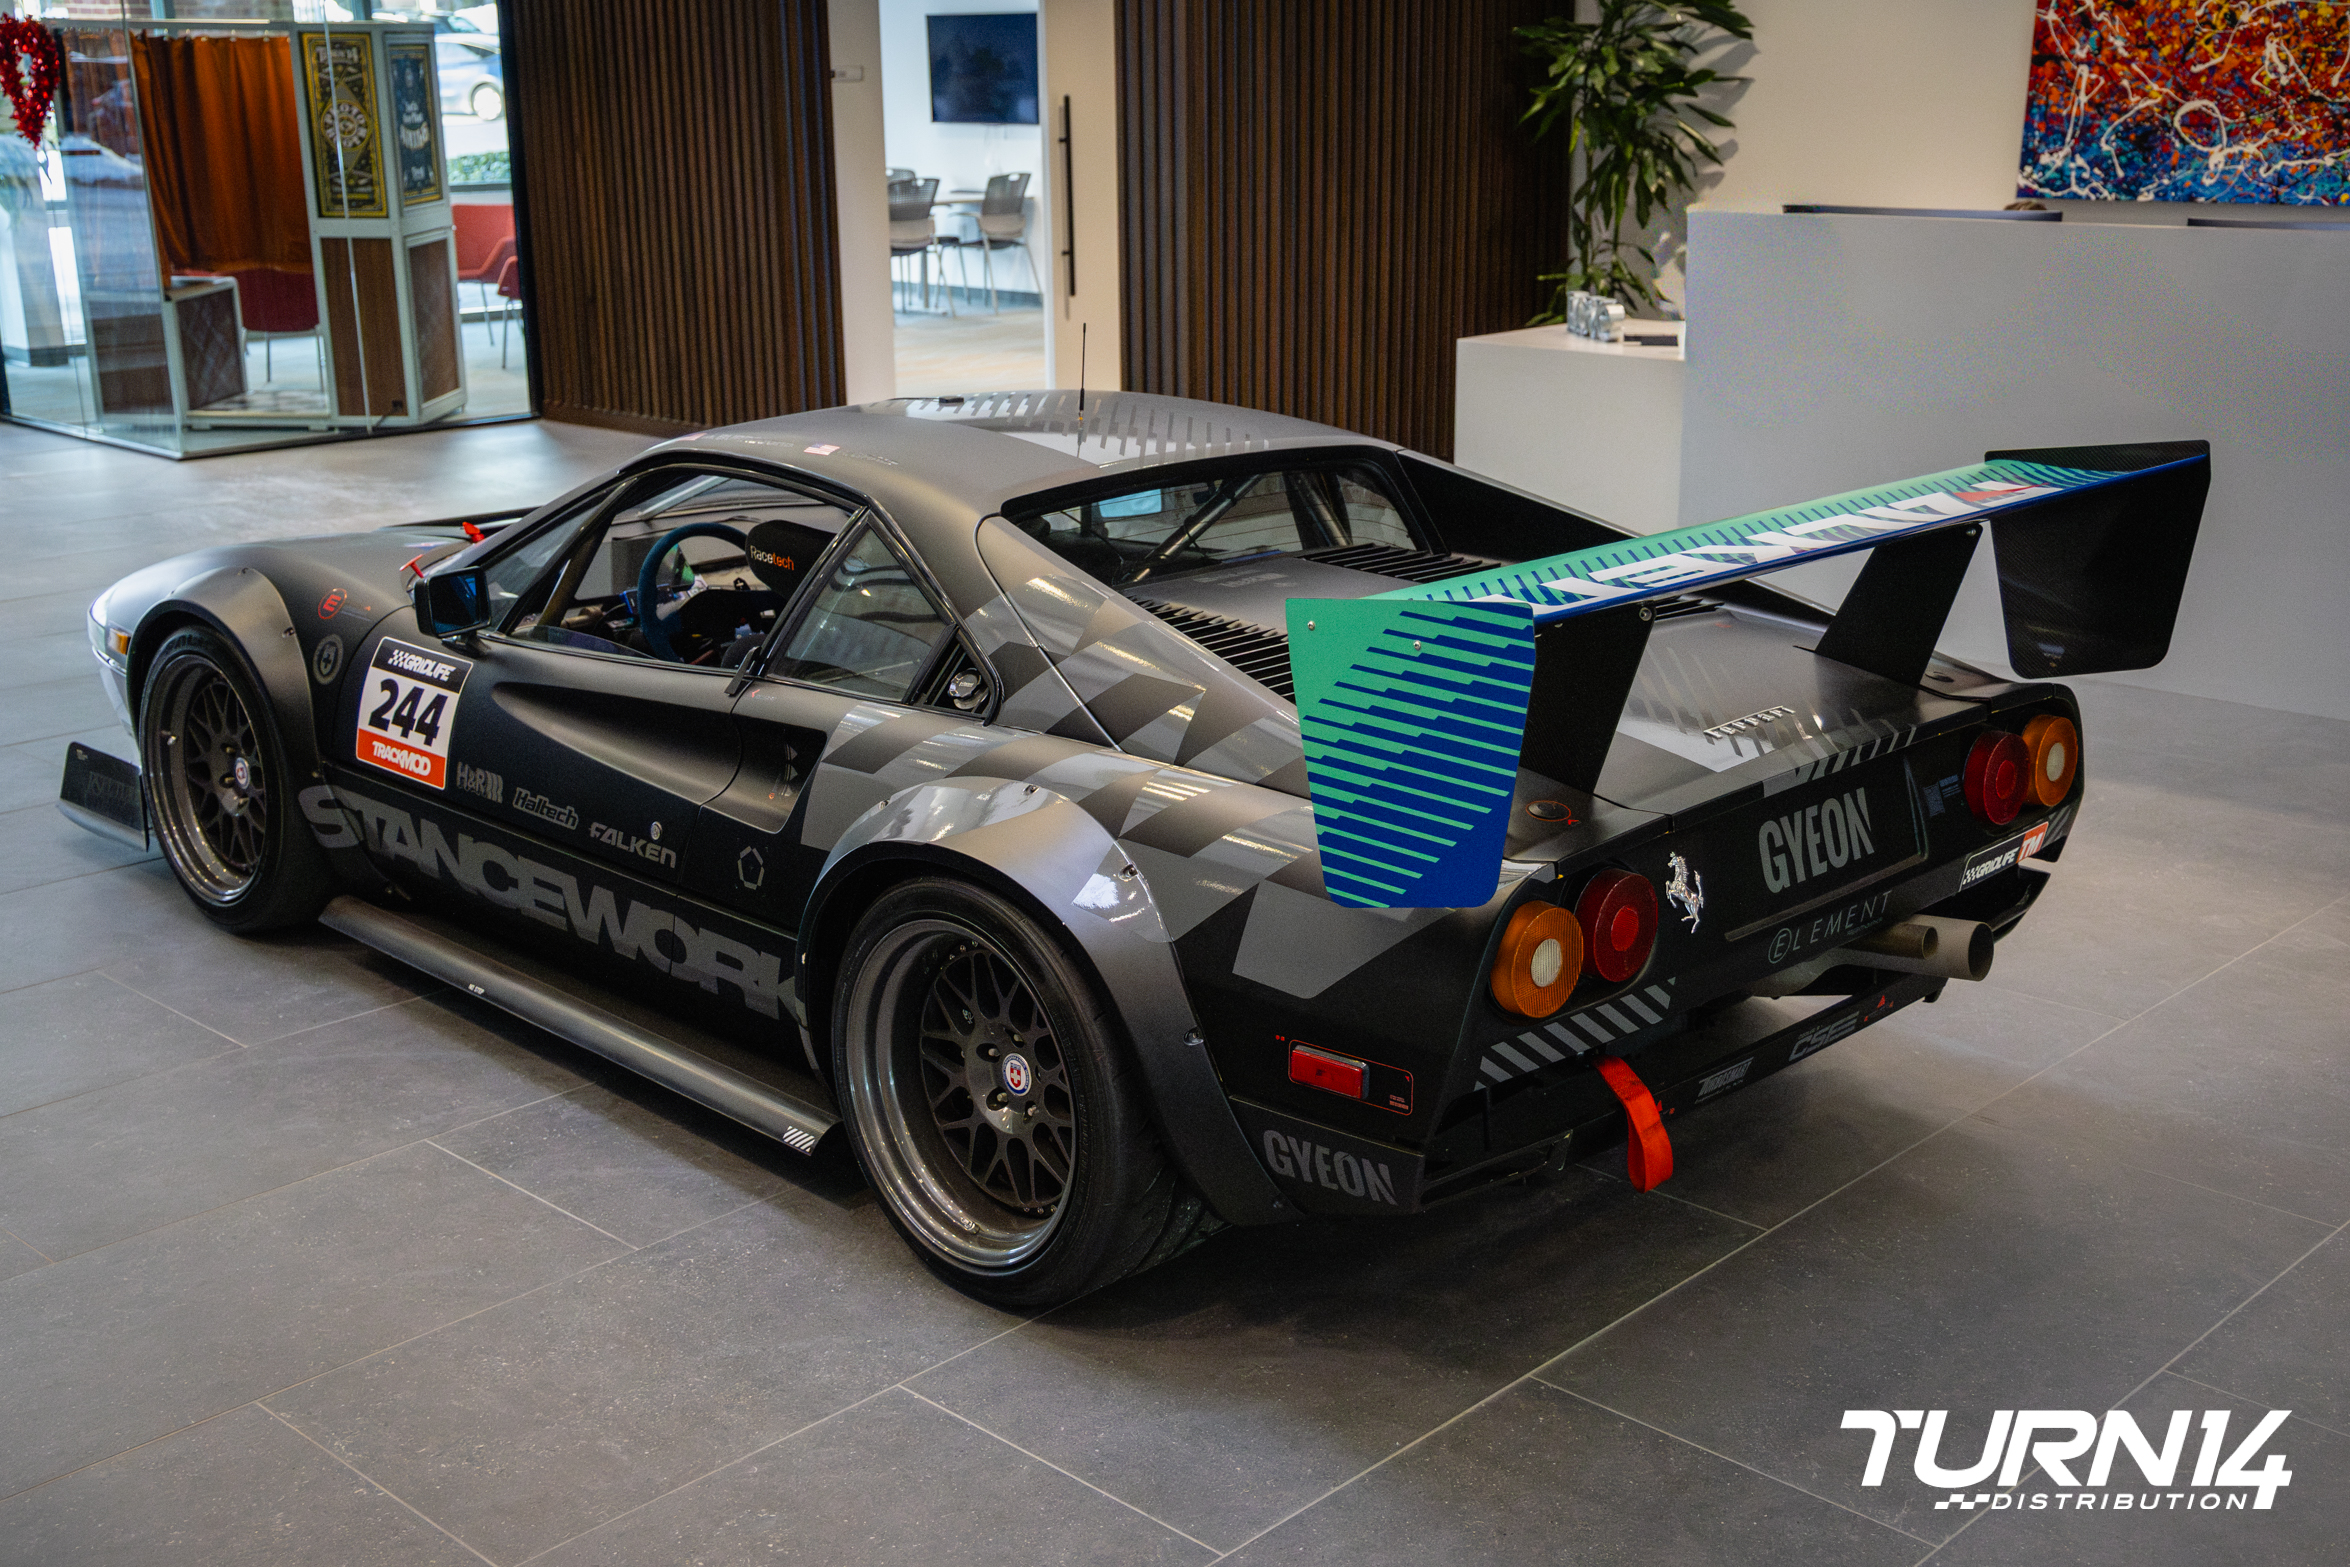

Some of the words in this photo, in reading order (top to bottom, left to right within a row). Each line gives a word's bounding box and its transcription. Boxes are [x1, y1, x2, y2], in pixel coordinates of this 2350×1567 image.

[750, 545, 795, 571] Racetech
[402, 654, 456, 682] GRIDLIFE
[368, 678, 448, 746] 244
[372, 741, 432, 776] TRACKMOD
[514, 788, 579, 830] Haltech
[589, 822, 677, 869] FALKEN
[1758, 787, 1875, 894] GYEON
[1976, 846, 2020, 878] GRIDLIFE
[2019, 832, 2044, 860] TM
[1768, 889, 1893, 964] ELEMENT
[1262, 1129, 1398, 1206] GYEON
